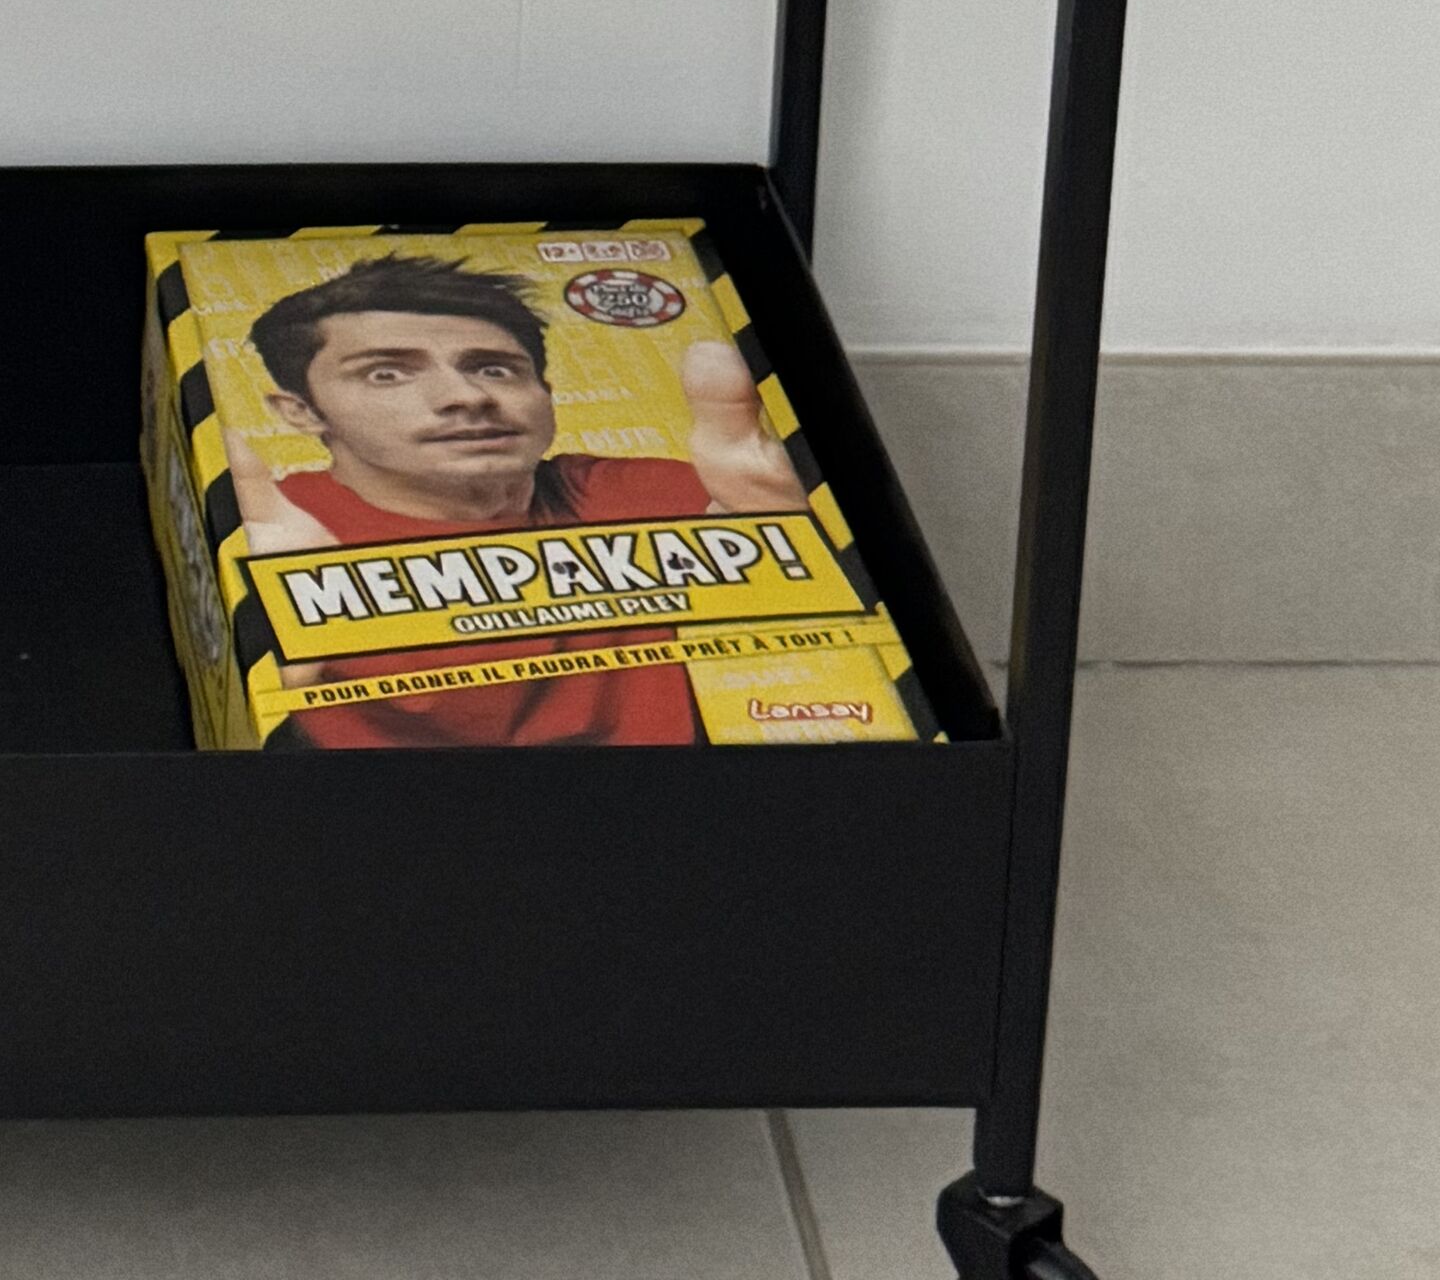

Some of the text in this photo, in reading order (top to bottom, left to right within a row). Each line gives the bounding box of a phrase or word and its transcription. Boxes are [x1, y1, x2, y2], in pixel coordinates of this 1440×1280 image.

[283, 524, 809, 625] MEMPAKAP!
[453, 593, 688, 634] GUILLAUME PLEY
[304, 683, 370, 705] POUR
[378, 671, 475, 695] GAGNER
[482, 666, 506, 682] IL
[513, 653, 609, 678] FAUDRA
[615, 646, 674, 666] ÊTRE
[681, 635, 742, 658] PRÊT
[751, 631, 769, 651] À
[774, 632, 834, 648] TOUT
[749, 698, 874, 724] Lansay
